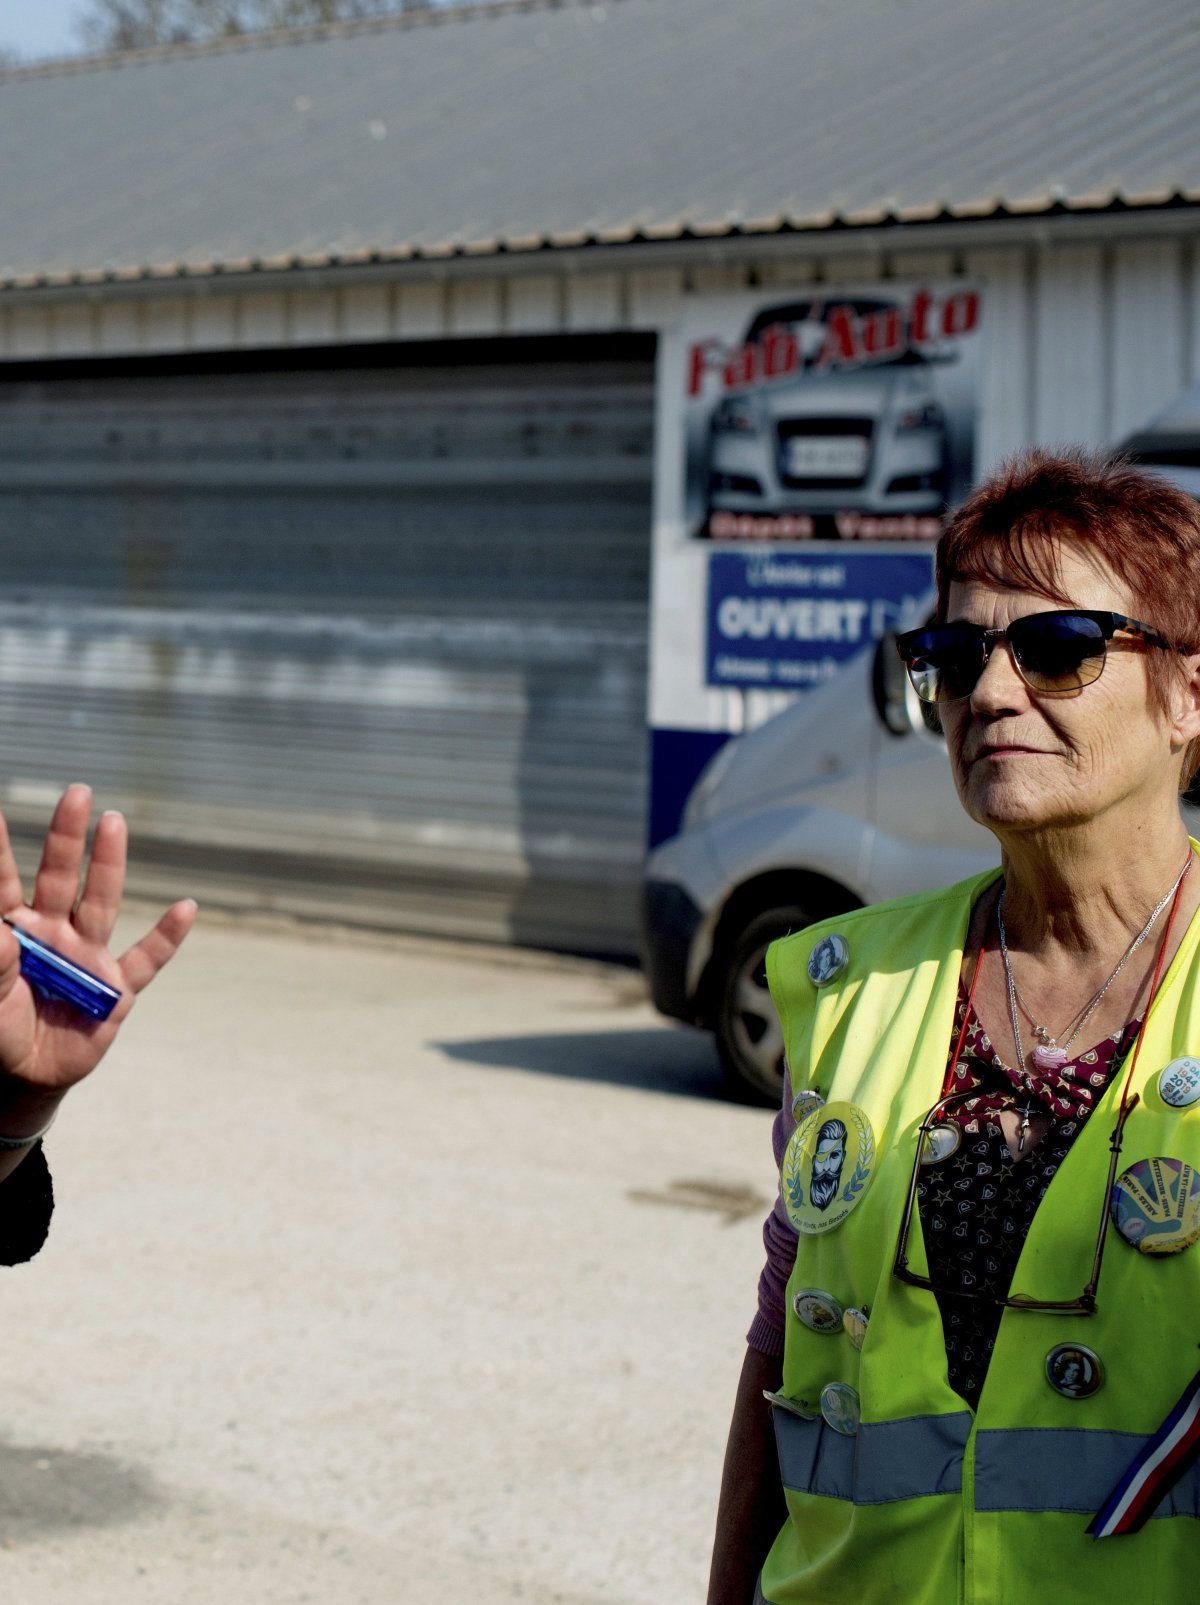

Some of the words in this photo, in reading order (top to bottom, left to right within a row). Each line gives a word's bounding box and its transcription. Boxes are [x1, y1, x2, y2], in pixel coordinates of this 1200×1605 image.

[688, 323, 797, 398] Fab
[816, 288, 983, 368] Auto
[719, 597, 866, 640] OUVERT
[1170, 1074, 1191, 1094] 2019
[1177, 1067, 1198, 1088] 1944
[1122, 1175, 1139, 1194] PARIS
[1152, 1159, 1166, 1198] BRUXELLES
[1139, 1195, 1158, 1216] ARLES
[1161, 1198, 1171, 1217] PARIS
